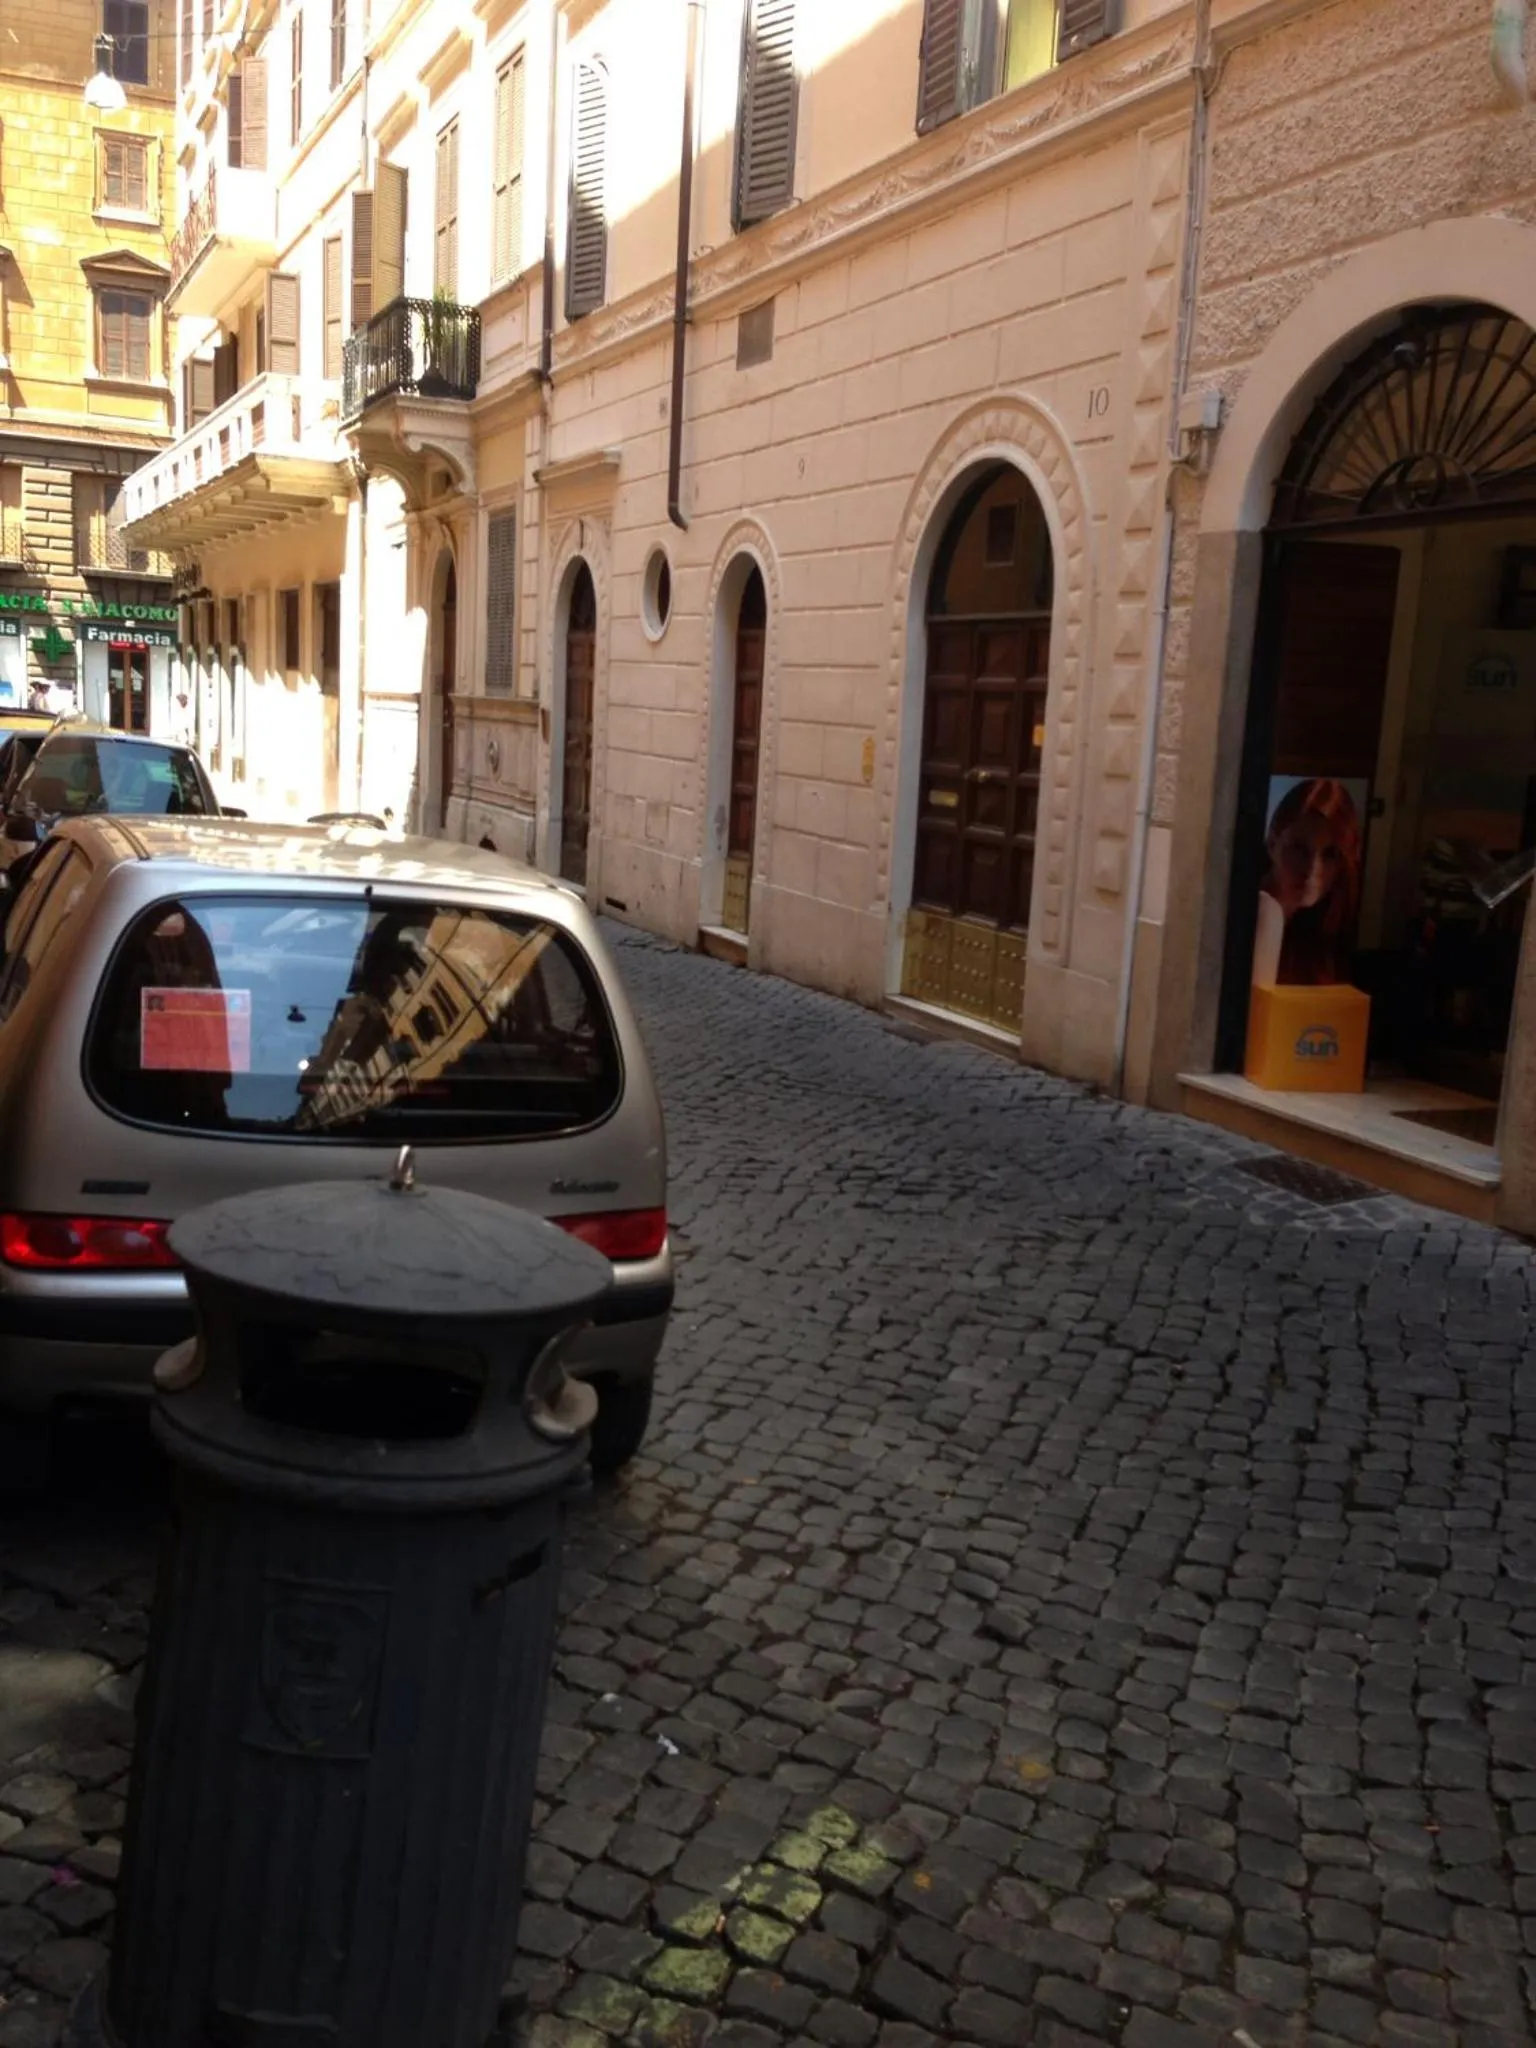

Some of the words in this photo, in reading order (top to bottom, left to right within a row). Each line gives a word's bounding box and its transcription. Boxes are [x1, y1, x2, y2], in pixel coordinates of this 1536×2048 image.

[1087, 386, 1110, 419] 10
[87, 626, 171, 646] Farmacia
[1295, 1039, 1339, 1057] sun
